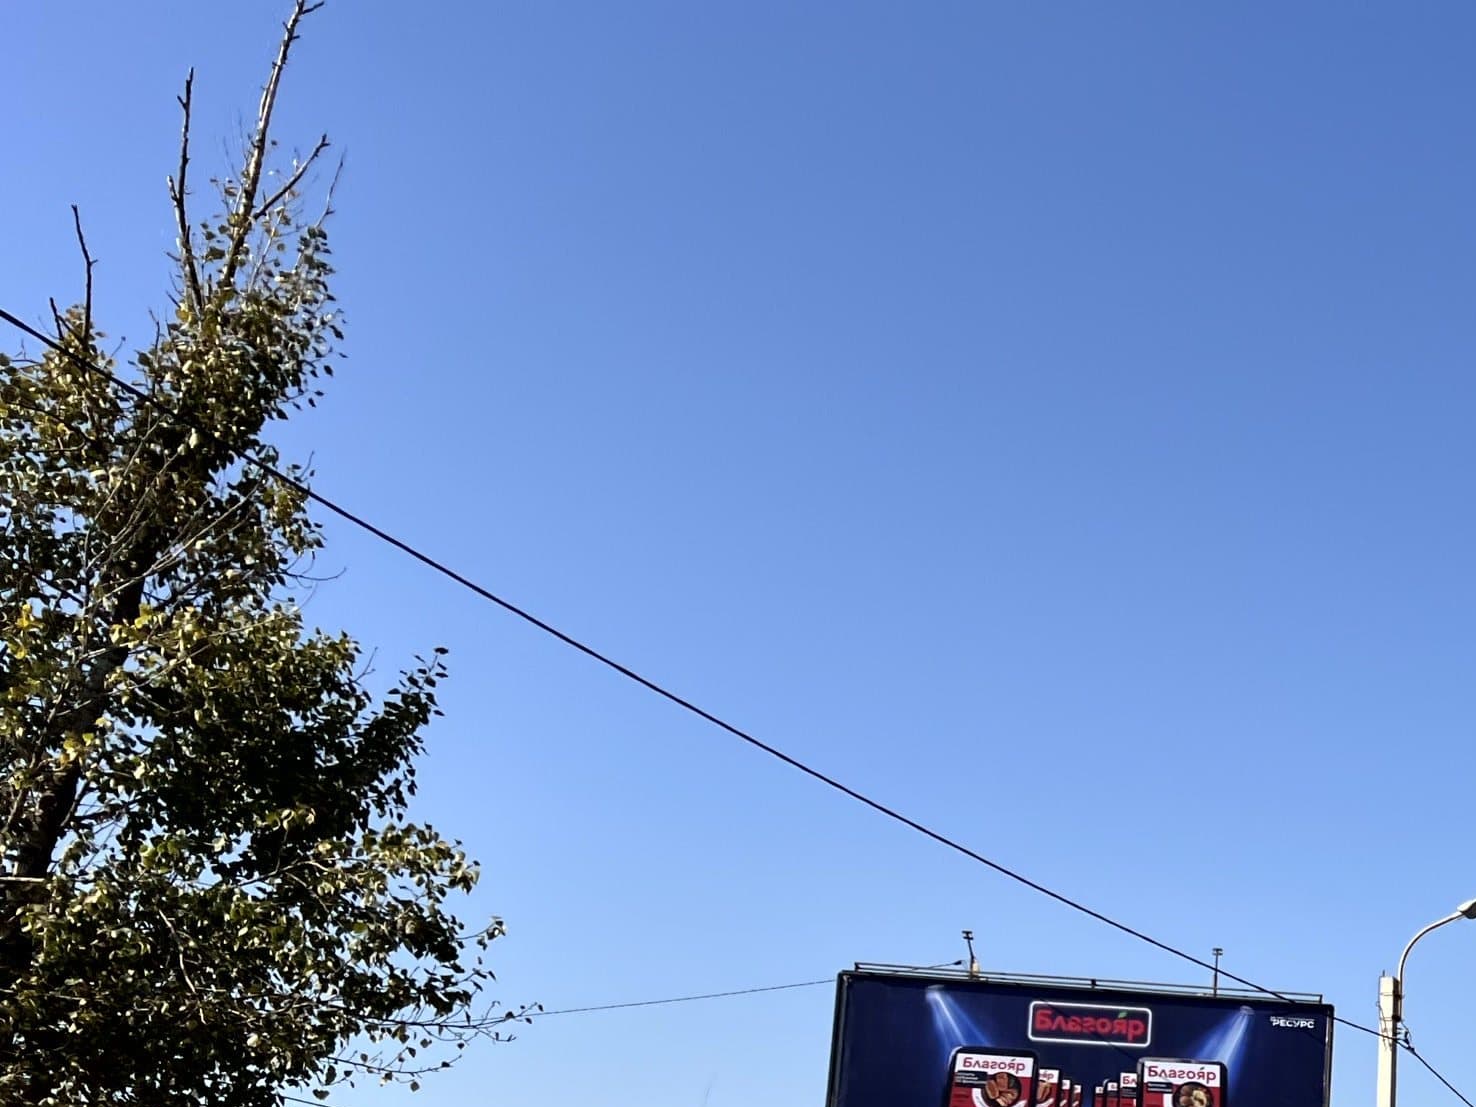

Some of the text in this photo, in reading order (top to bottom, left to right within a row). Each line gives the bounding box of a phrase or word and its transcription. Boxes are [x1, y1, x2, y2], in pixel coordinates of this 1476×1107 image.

[1034, 1009, 1145, 1042] Благояр
[1272, 1018, 1315, 1029] РЕСУРС
[963, 1057, 1026, 1073] Благояр
[1148, 1065, 1217, 1084] Благояр
